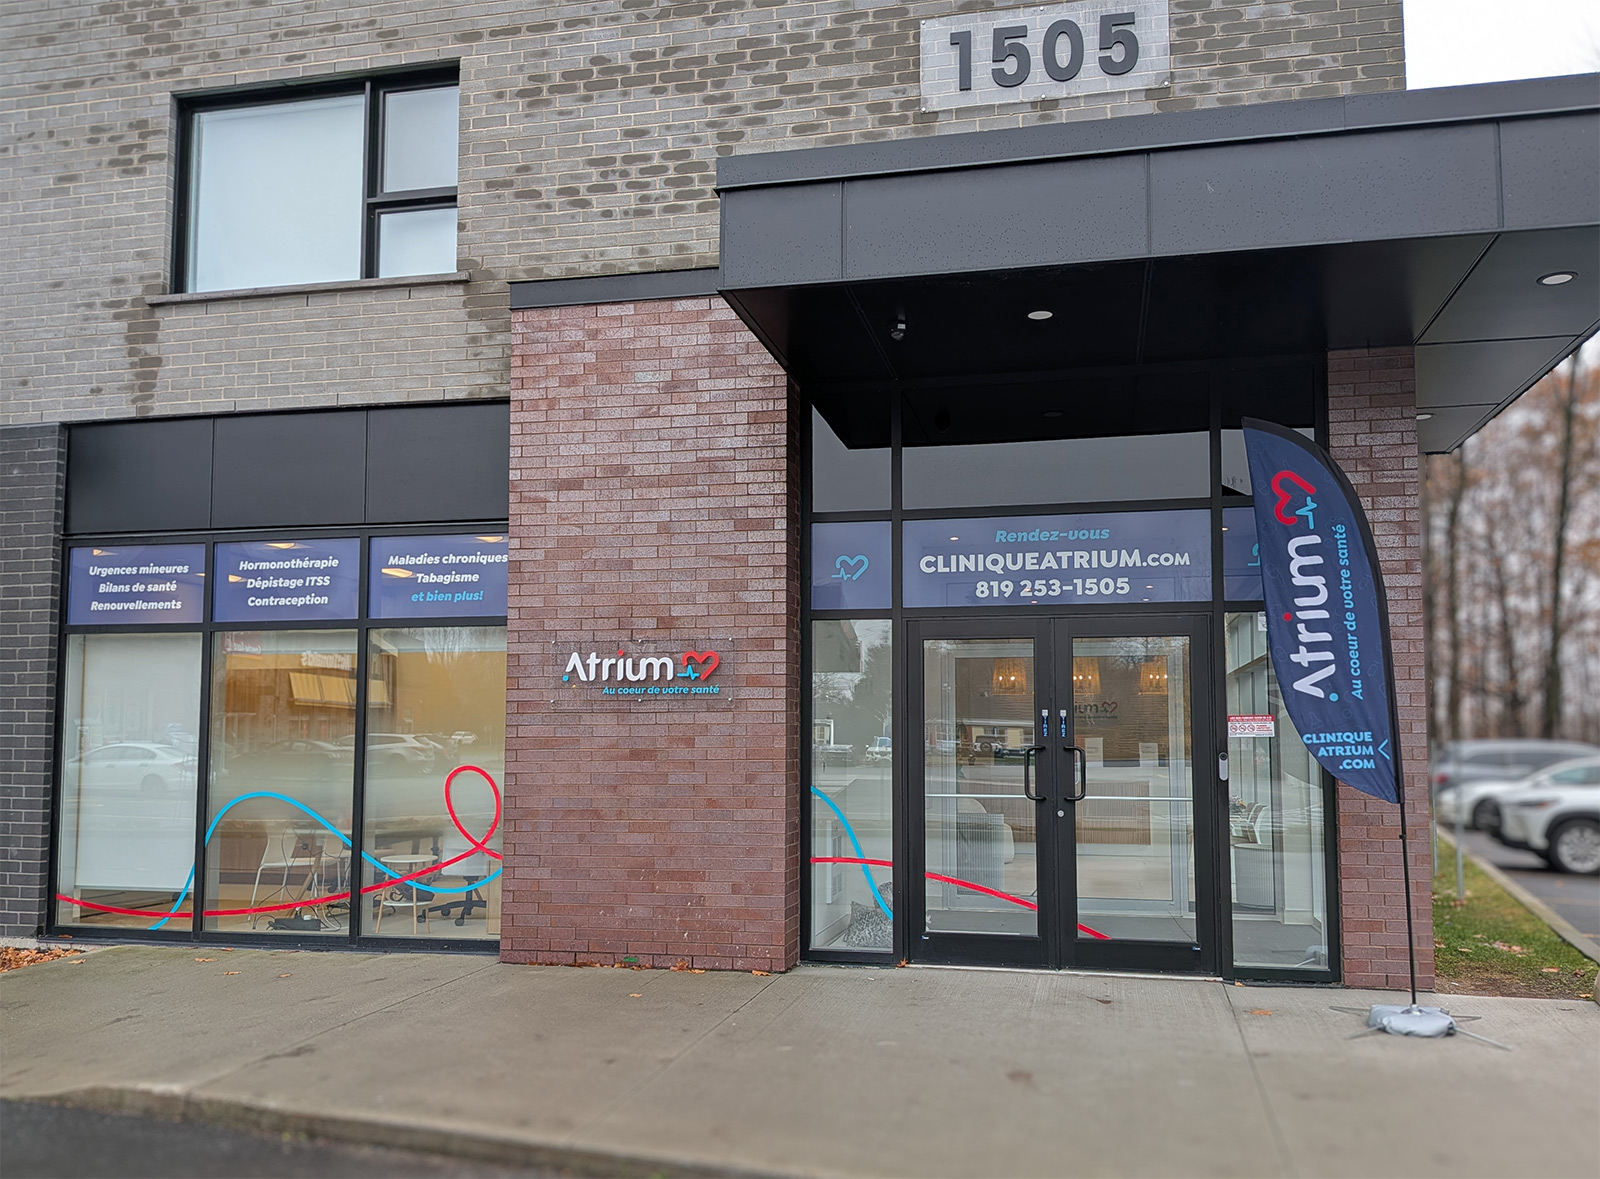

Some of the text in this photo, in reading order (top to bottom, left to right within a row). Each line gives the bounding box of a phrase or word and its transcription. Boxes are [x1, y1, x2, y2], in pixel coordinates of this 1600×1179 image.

[950, 12, 1140, 91] 1505
[995, 528, 1110, 542] Rendez-vous
[239, 556, 339, 570] Hormonothérapie
[388, 551, 508, 565] Maladies chroniques
[89, 563, 189, 577] Urgences mineures
[246, 576, 330, 590] Dépistage ITSS
[416, 571, 479, 584] Tabagisme
[98, 580, 177, 593] Bilans de santé
[975, 577, 1130, 598] 819 253-1505
[247, 593, 328, 606] Contraception
[411, 590, 484, 603] et bien plus!
[90, 600, 182, 611] Renouvellements
[1332, 523, 1363, 700] Au coeur de votre santé
[1283, 534, 1338, 702] Atrium
[563, 649, 674, 682] Atrium
[602, 684, 719, 695] Au coeur de votre santé
[1302, 731, 1373, 744] CLINIQUE
[1318, 745, 1374, 757] ATRIUM
[1339, 758, 1376, 770] .COM
